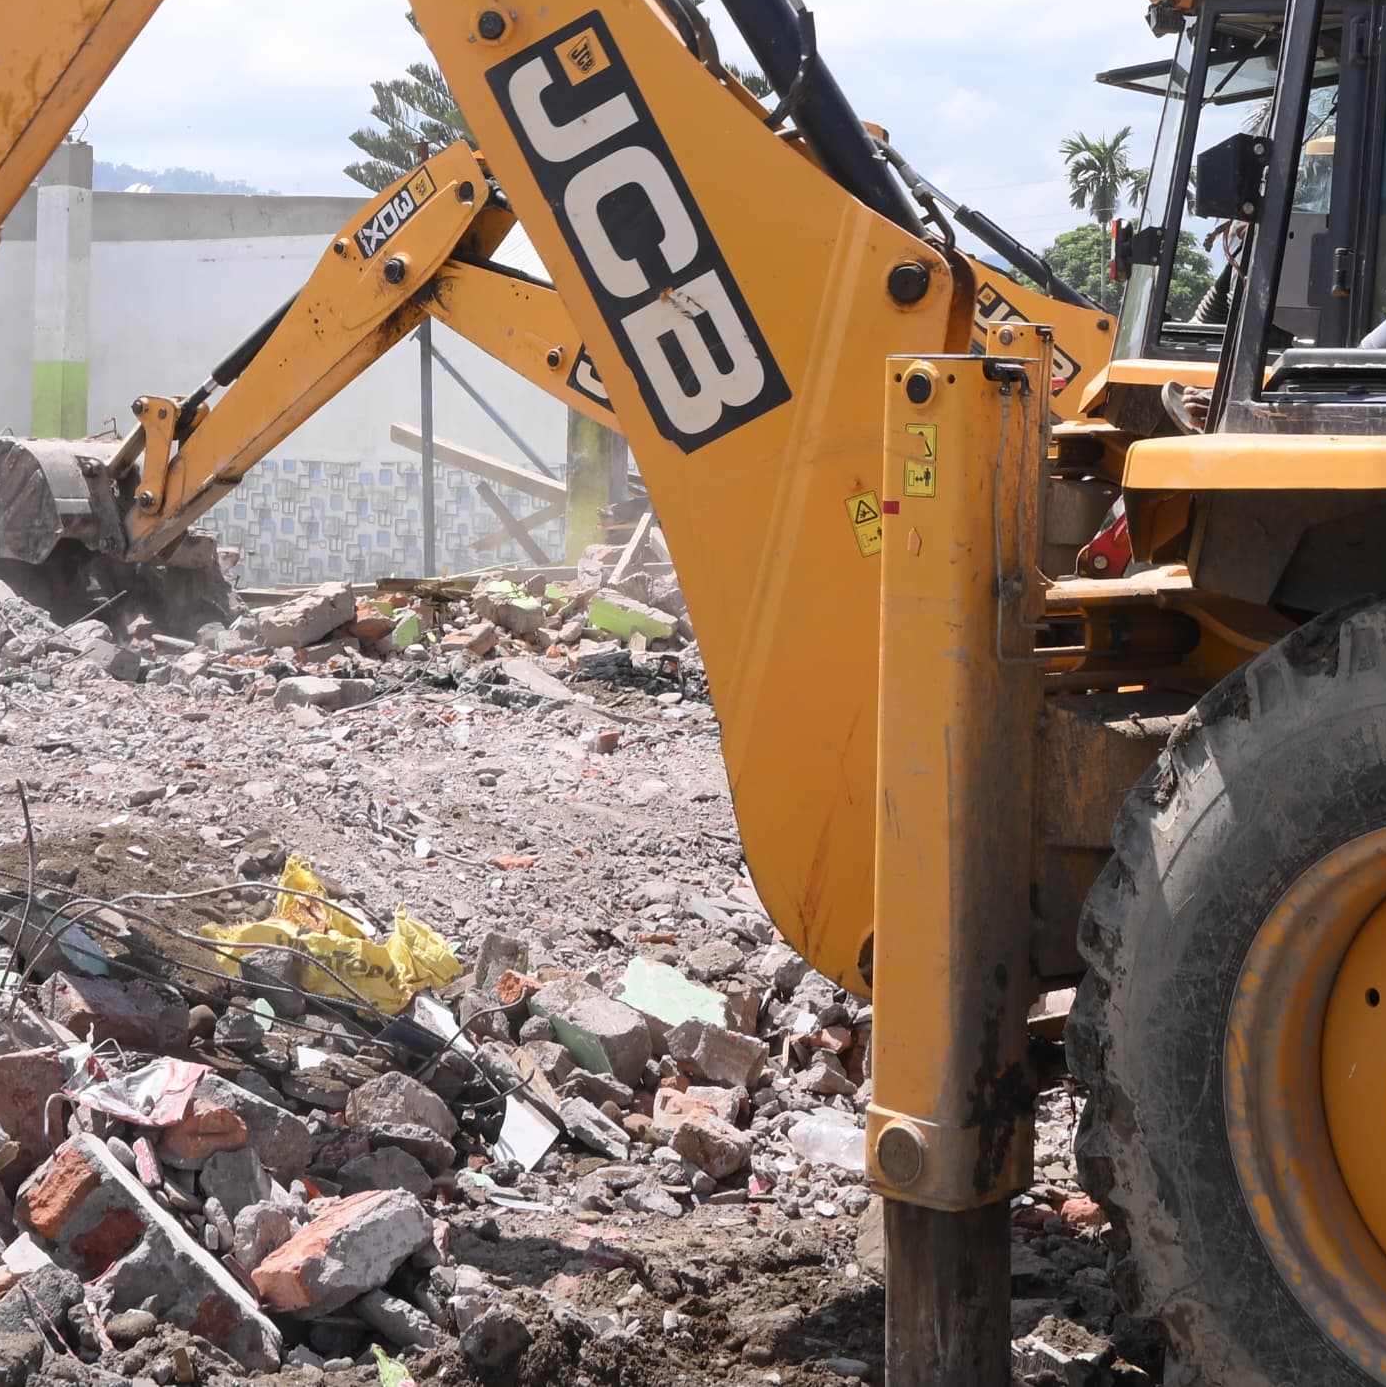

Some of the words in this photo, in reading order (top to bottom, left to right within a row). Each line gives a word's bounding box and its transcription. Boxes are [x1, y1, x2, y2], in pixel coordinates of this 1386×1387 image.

[570, 42, 593, 72] JCB
[361, 190, 415, 252] 3DX
[508, 56, 765, 435] JCB
